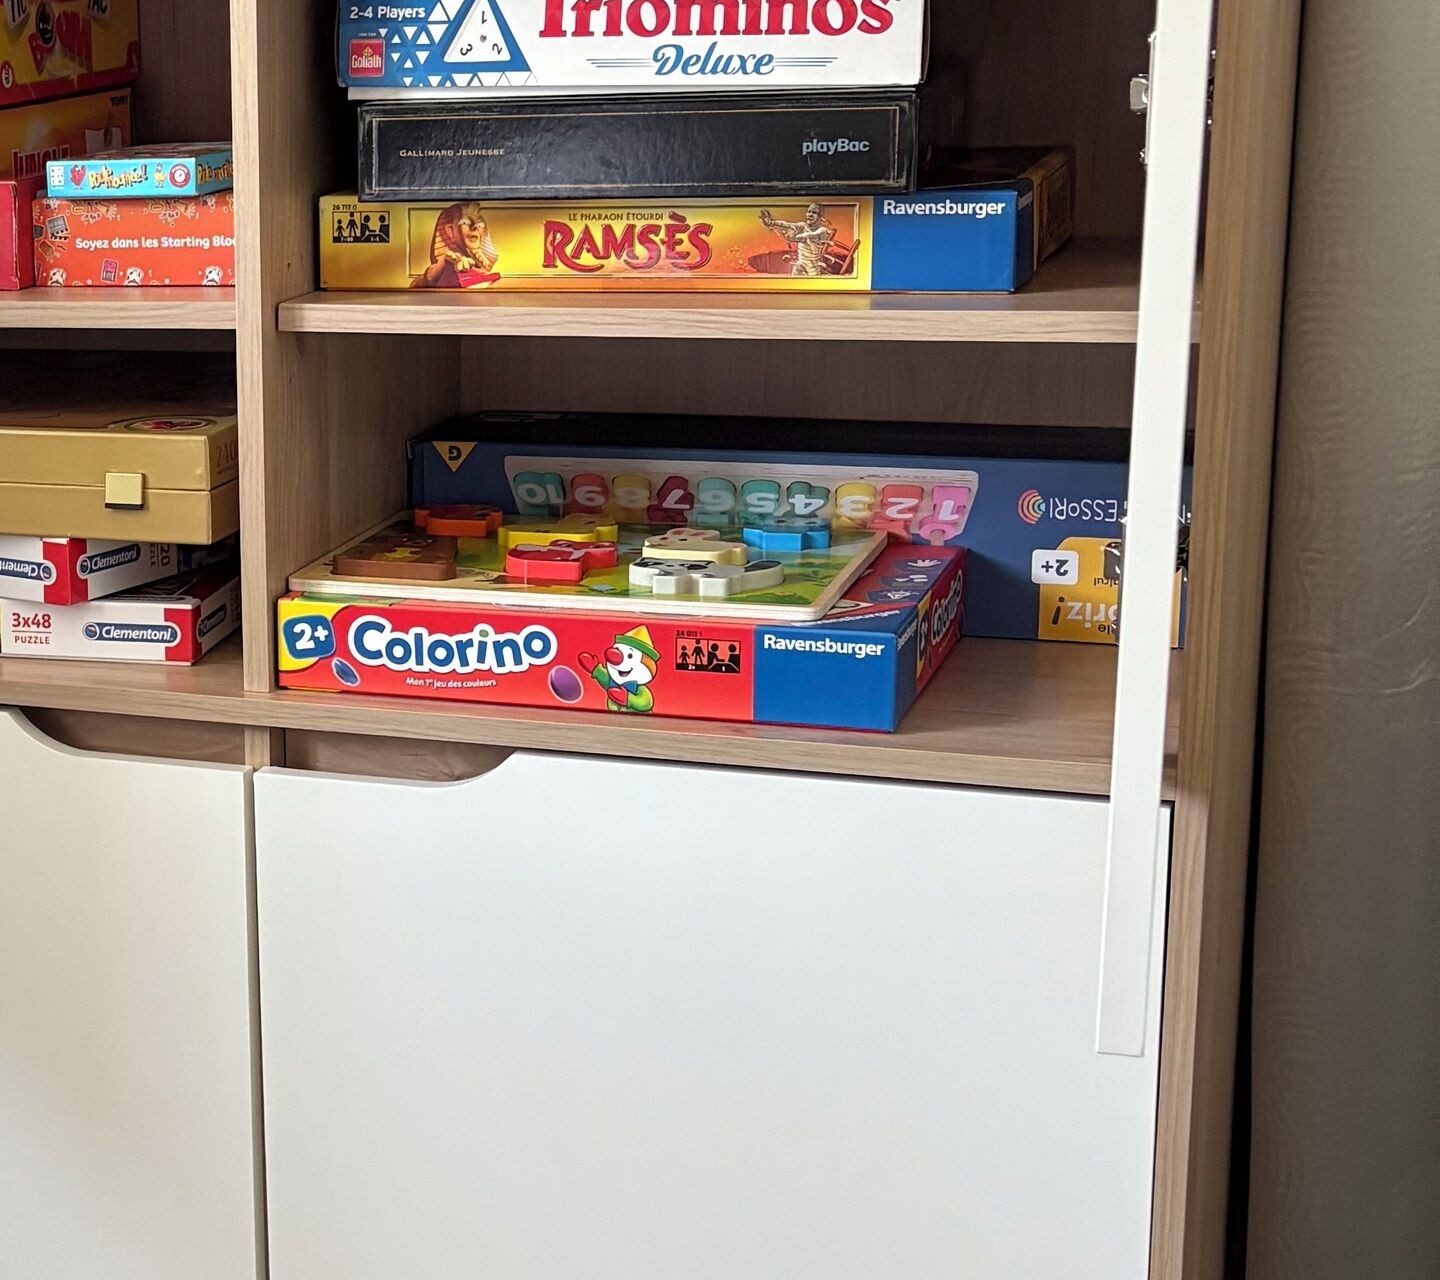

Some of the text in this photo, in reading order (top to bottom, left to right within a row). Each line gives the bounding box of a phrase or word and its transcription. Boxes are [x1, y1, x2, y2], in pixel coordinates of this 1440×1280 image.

[349, 6, 426, 21] 2-4 Players
[351, 54, 382, 69] Goliath
[652, 41, 776, 76] Deluxe
[802, 138, 870, 156] playBac
[568, 210, 664, 221] LE PHARAON ÉTOURDI
[882, 199, 1006, 219] Ravensburger
[75, 237, 109, 251] Soyez
[112, 237, 139, 249] dans
[142, 236, 159, 248] les
[161, 235, 210, 250] Starting
[542, 210, 713, 273] RAMSÈS
[91, 546, 138, 571] Clementoni
[1041, 558, 1069, 577] 2+
[11, 612, 52, 629] 3x48
[14, 635, 51, 645] PUZZLE
[101, 625, 172, 642] Clementoni
[292, 621, 330, 652] 2+
[351, 619, 553, 669] Colorino
[763, 633, 886, 659] Ravensburger
[406, 676, 424, 687] Mon
[447, 678, 462, 688] des
[463, 678, 497, 688] couleurs
